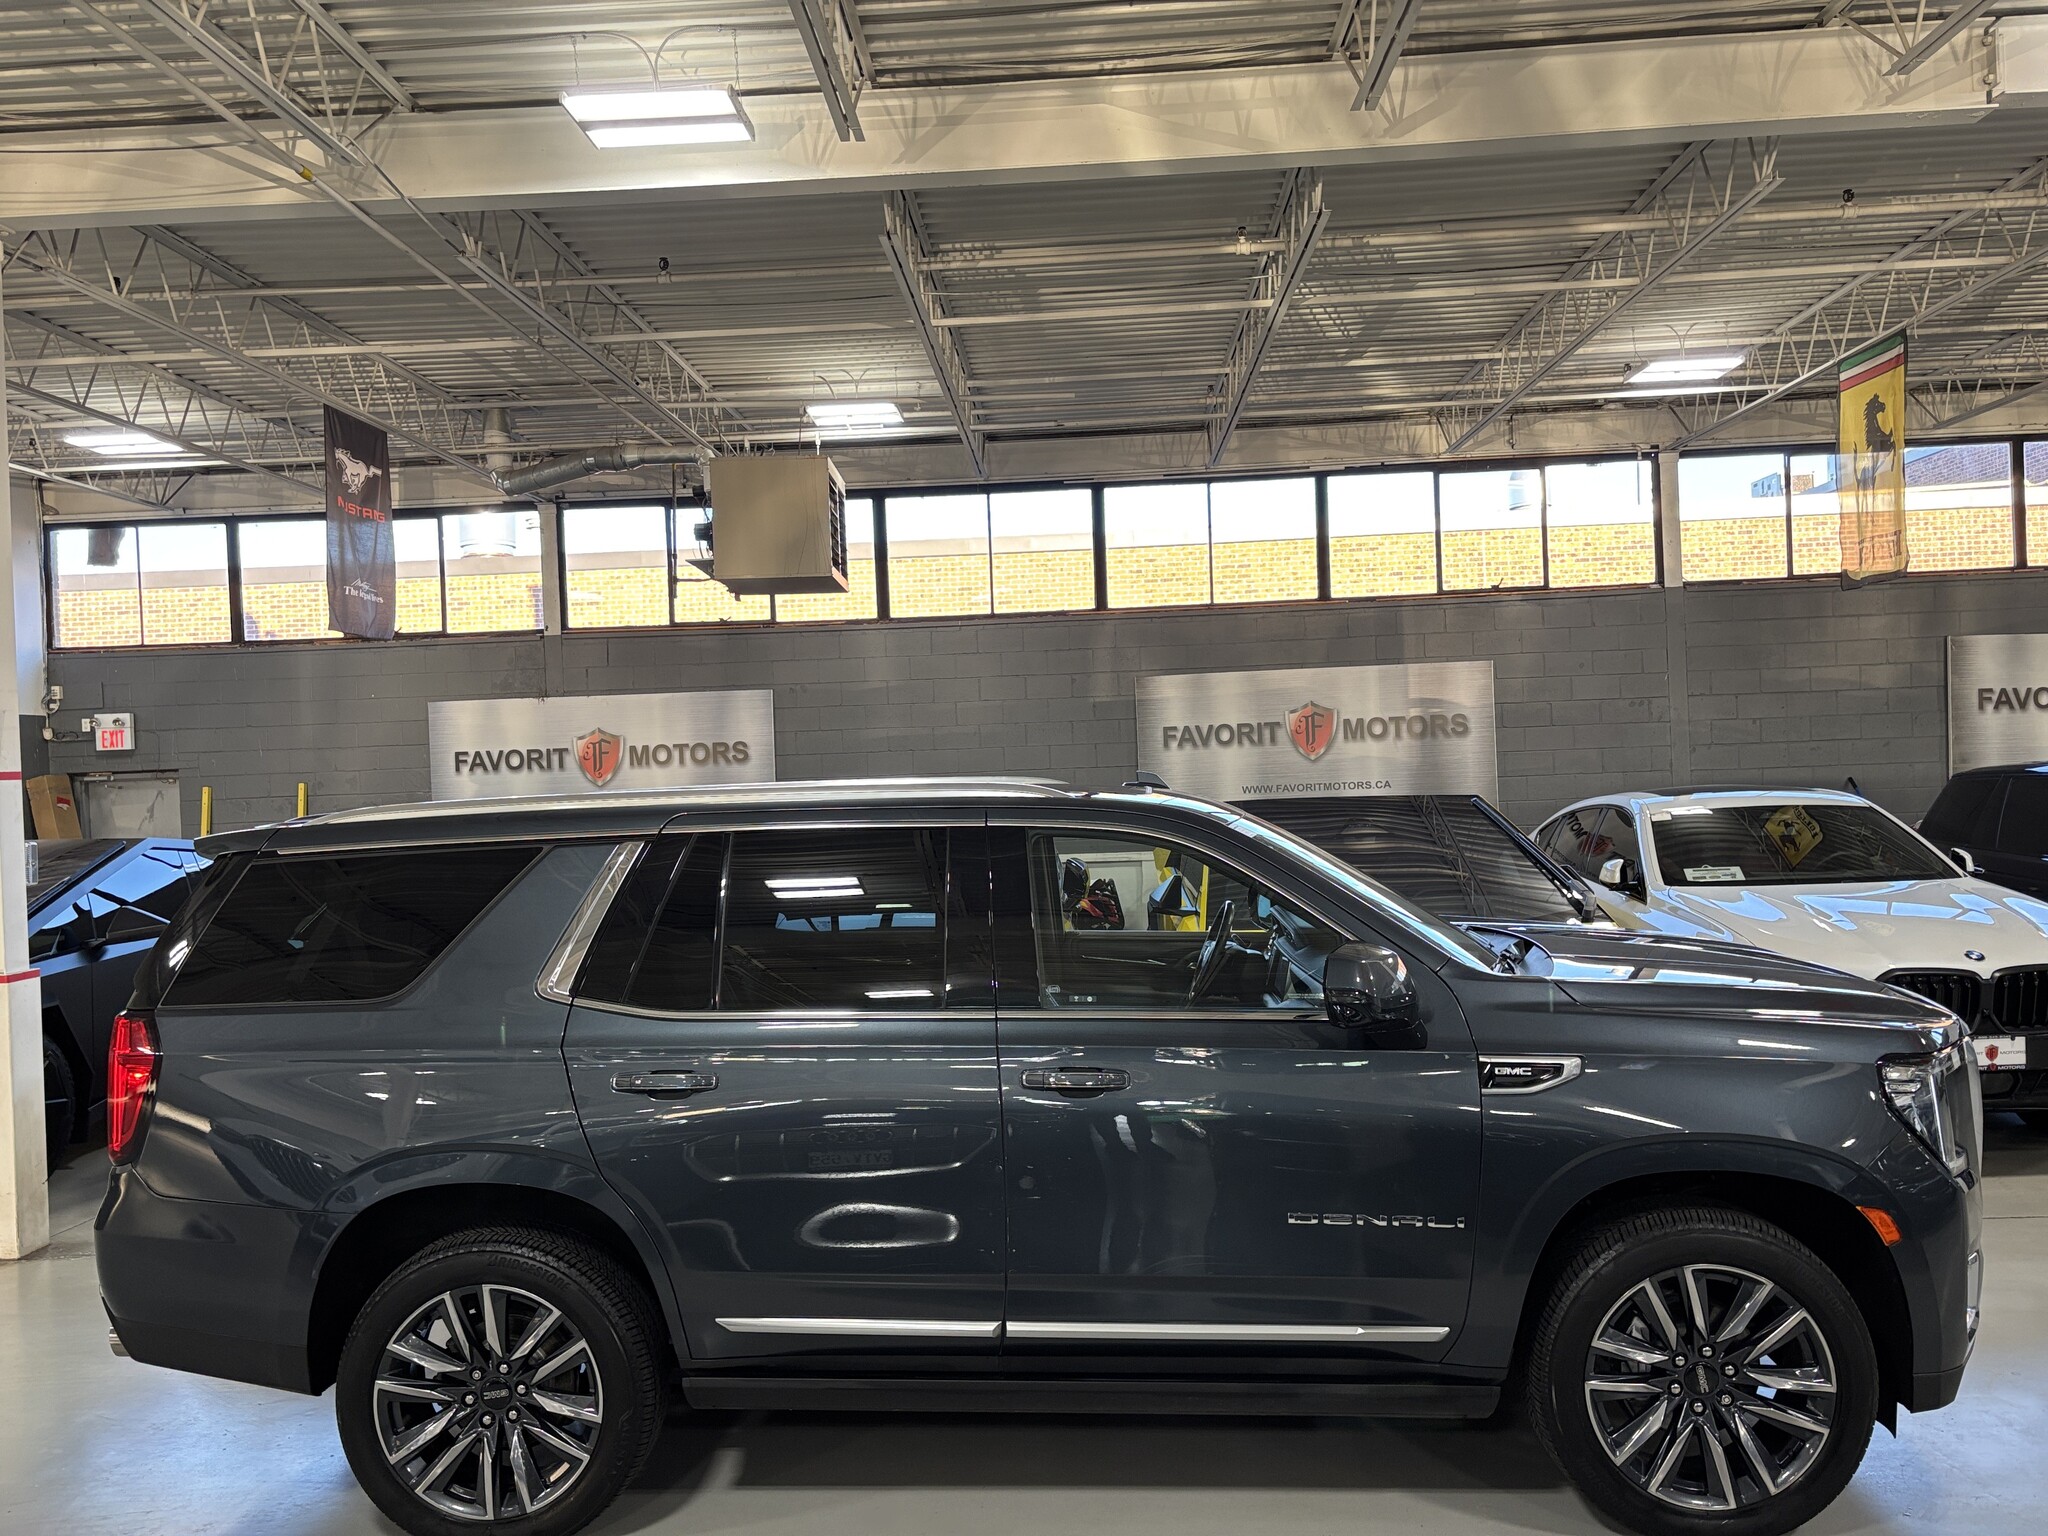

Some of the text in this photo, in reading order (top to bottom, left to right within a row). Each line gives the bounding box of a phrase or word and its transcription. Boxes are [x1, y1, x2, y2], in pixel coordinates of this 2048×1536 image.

[343, 585, 359, 597] The
[101, 730, 125, 748] EXIT
[1162, 720, 1280, 748] FAVORIT
[1342, 713, 1469, 740] MOTORS
[454, 747, 569, 772] FAVORIT
[629, 740, 749, 767] MOTORS
[1242, 780, 1392, 794] WWW.FAVORITMOTORS.CA
[1494, 1067, 1532, 1076] GMC
[1288, 1212, 1465, 1229] DENALI
[1695, 1365, 1709, 1394] GMC
[483, 1389, 509, 1400] GMC
